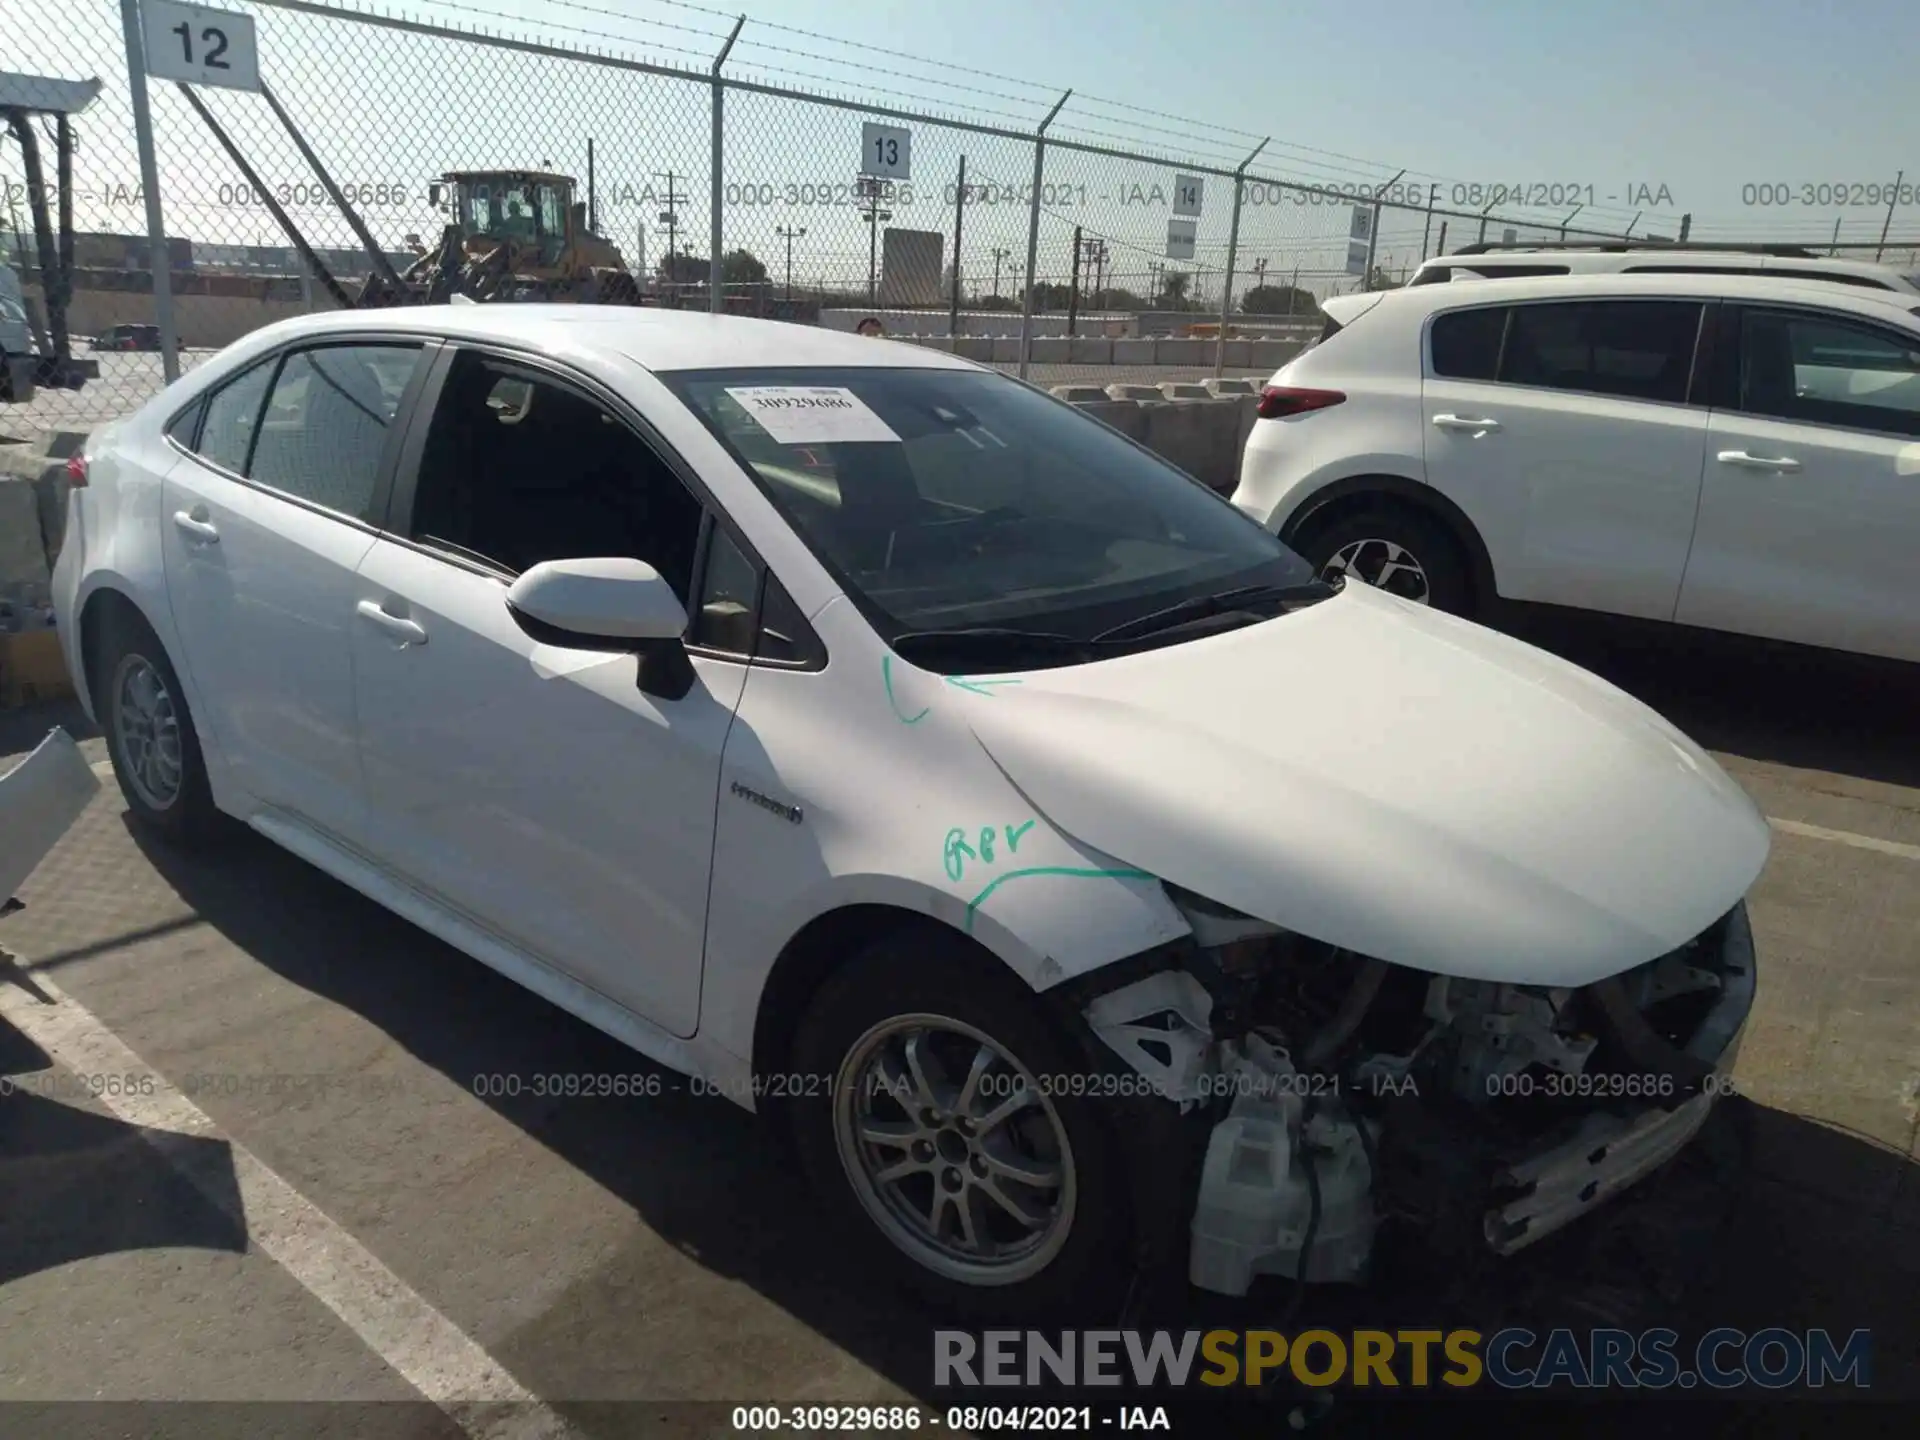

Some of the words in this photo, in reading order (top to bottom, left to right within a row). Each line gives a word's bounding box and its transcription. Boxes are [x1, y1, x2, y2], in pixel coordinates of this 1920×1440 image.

[173, 21, 230, 69] 12
[875, 137, 898, 166] 13
[1180, 184, 1197, 208] 14
